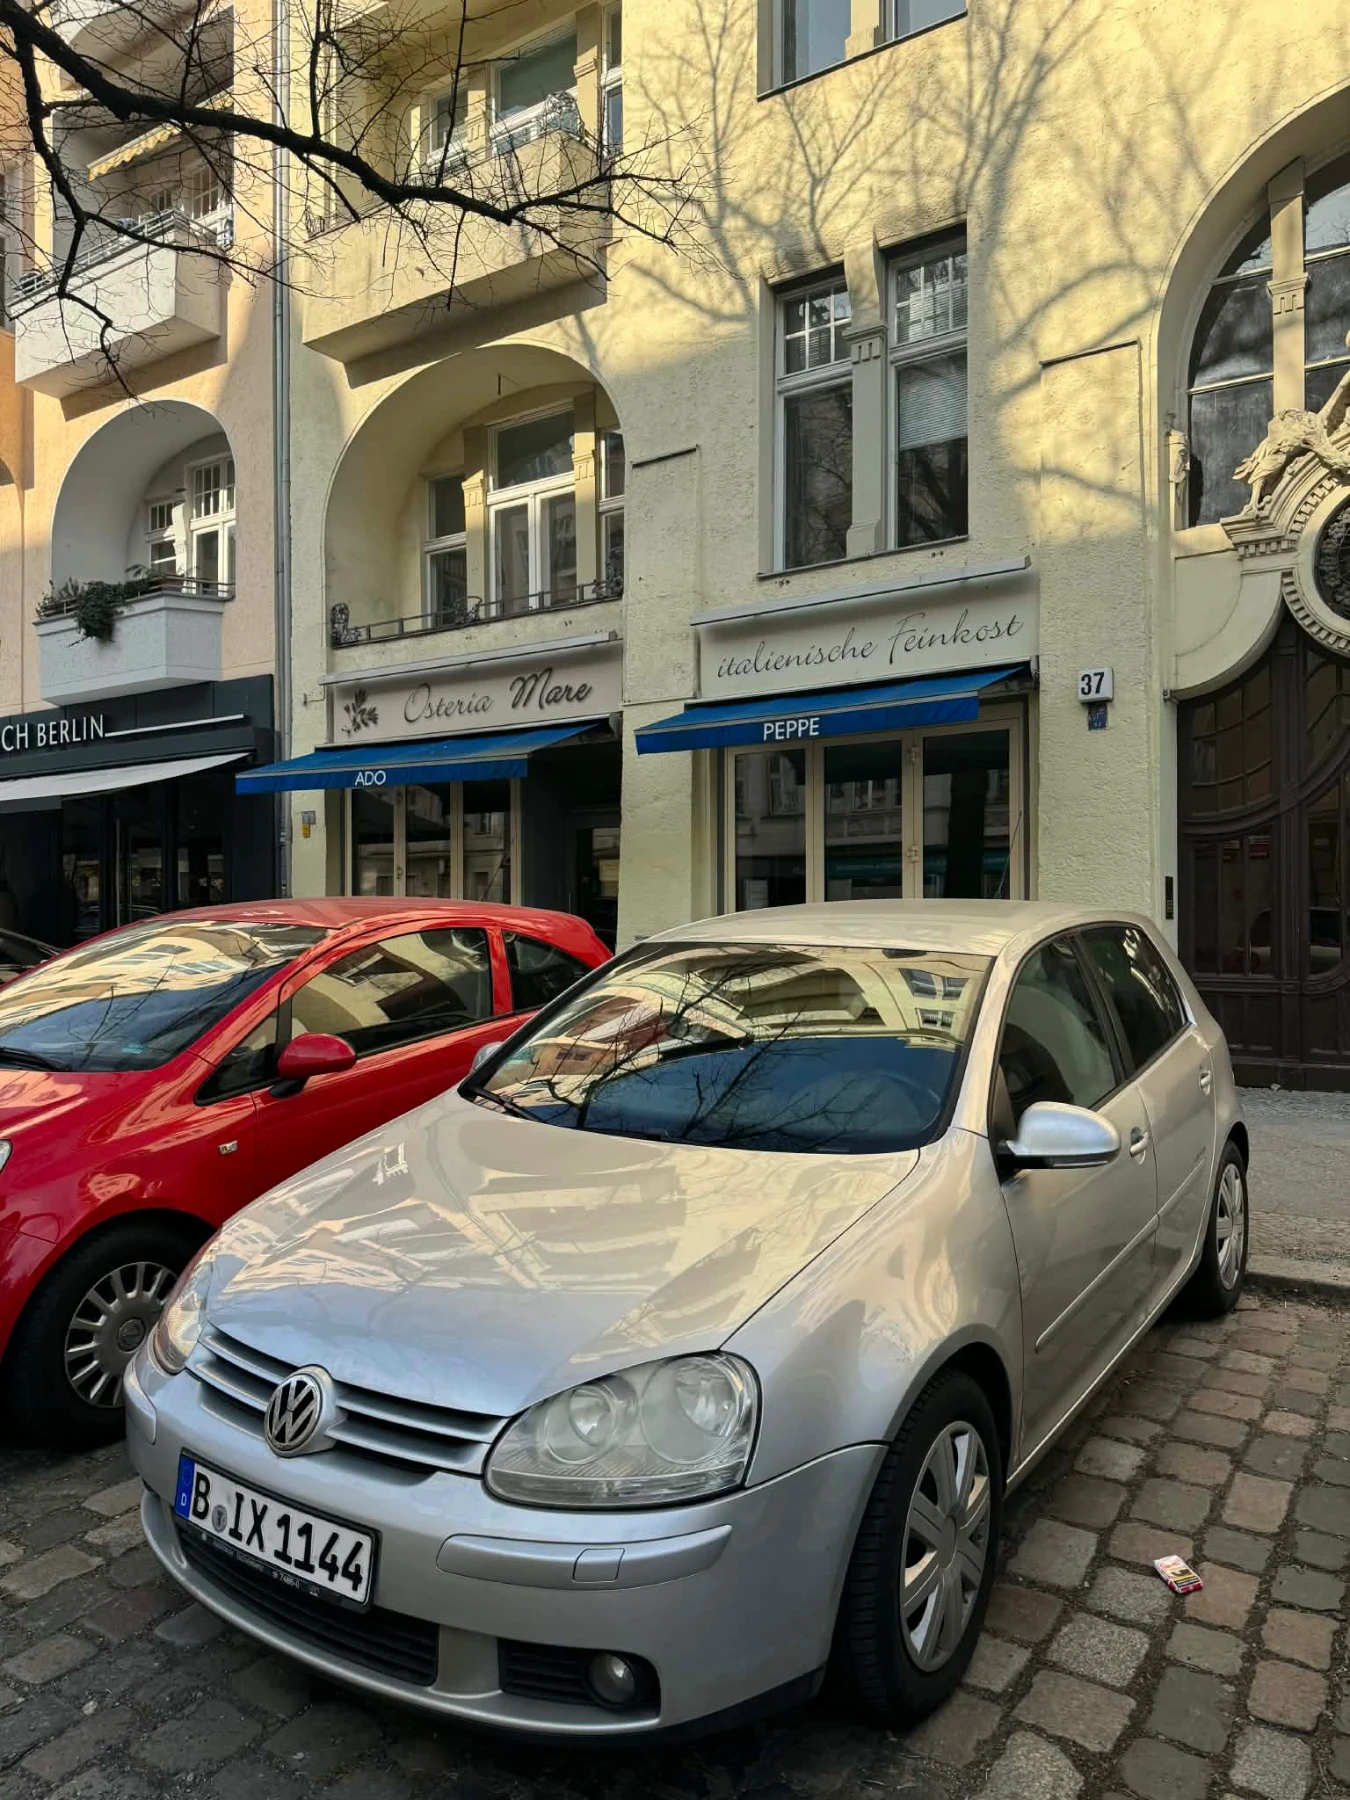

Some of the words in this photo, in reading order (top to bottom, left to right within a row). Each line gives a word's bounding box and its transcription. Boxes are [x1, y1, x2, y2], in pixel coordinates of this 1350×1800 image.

[717, 627, 877, 678] italienische
[888, 608, 1026, 664] Feinkost
[403, 682, 494, 723] Osteria
[508, 667, 593, 710] Mare
[1081, 671, 1105, 695] 37
[1, 722, 28, 751] CH
[37, 713, 104, 748] BERLIN
[763, 717, 820, 741] PEPPE
[354, 770, 387, 787] ADO
[192, 1471, 211, 1520] B
